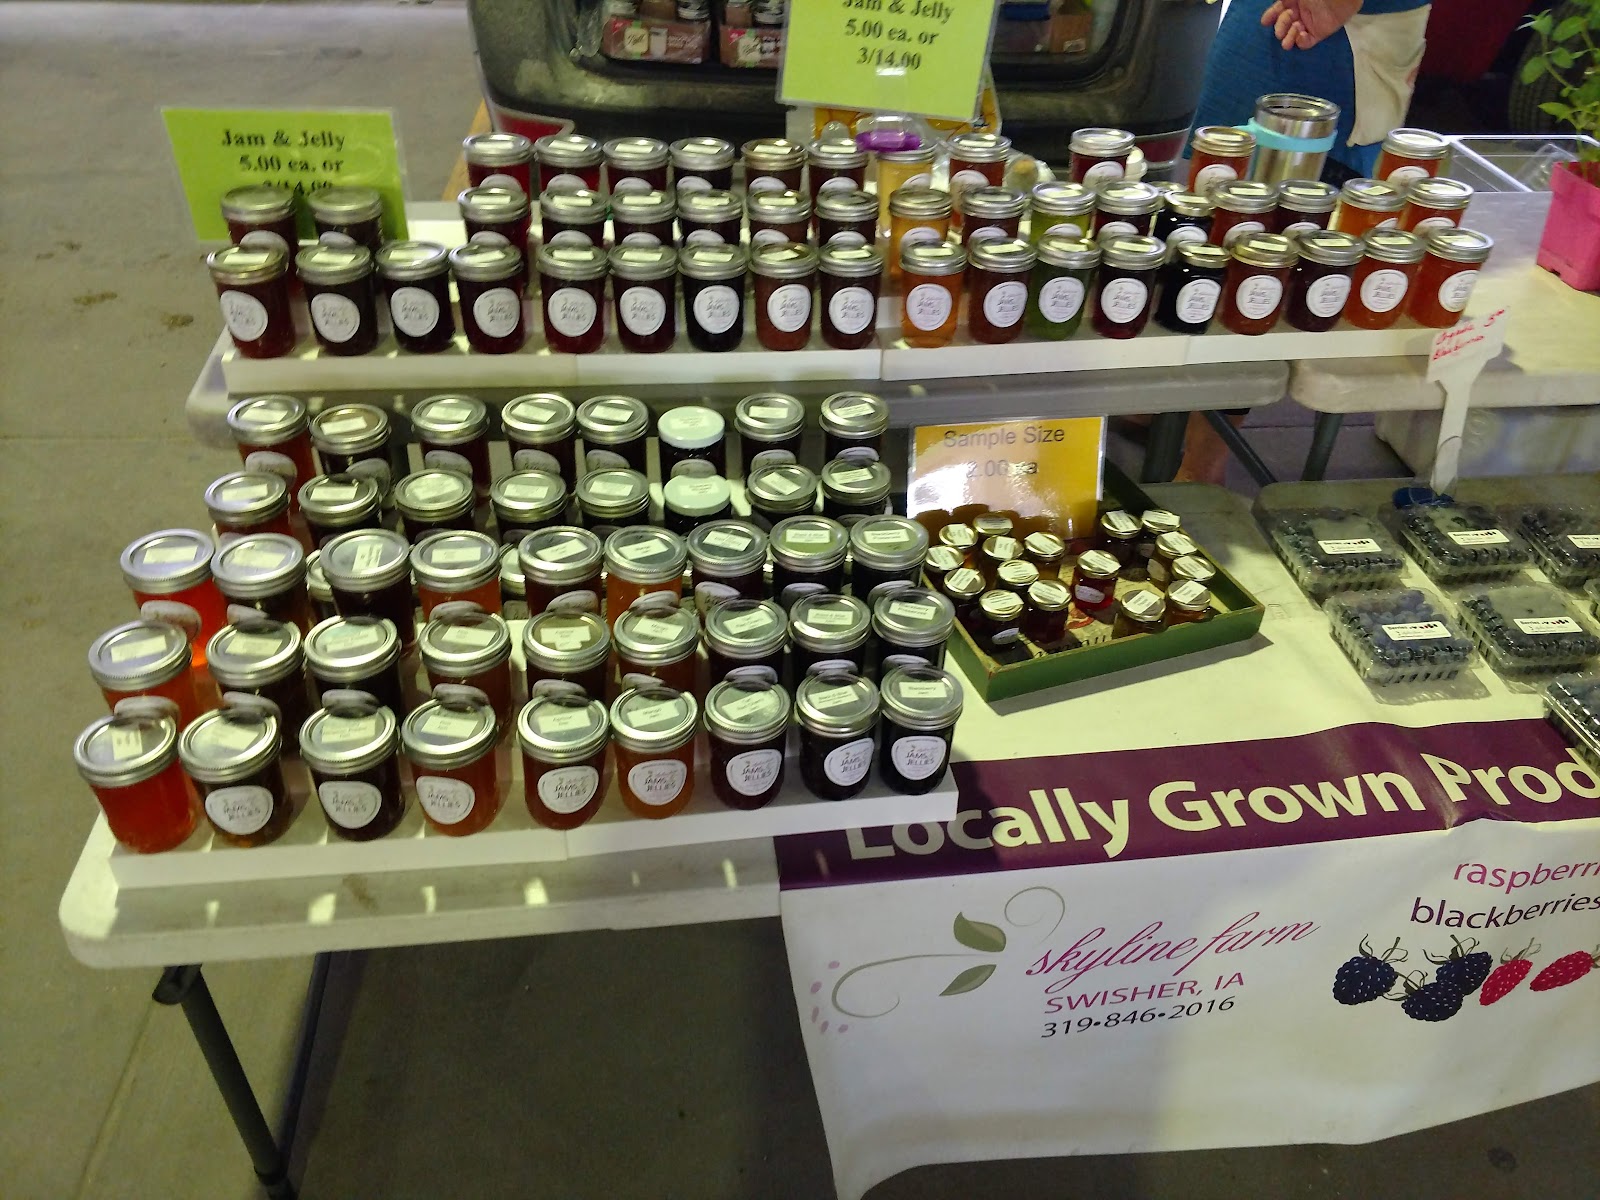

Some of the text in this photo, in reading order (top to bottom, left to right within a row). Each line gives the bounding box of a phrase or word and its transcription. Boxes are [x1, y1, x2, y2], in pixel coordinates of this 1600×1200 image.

[888, 0, 905, 14] &
[911, 0, 955, 25] Jelly
[846, 18, 939, 45] 5.00 ea. or
[857, 47, 921, 70] 3/14.00
[221, 128, 345, 153] Jam & Jelly
[240, 154, 344, 172] 5.00 ea. or
[944, 426, 1065, 449] Sample Size
[846, 788, 1129, 859] Locally
[1148, 771, 1426, 831] Grown
[1410, 893, 1600, 929] blackberries
[1025, 911, 1321, 994] skyline farm
[1044, 972, 1245, 1014] SWISHER, IA
